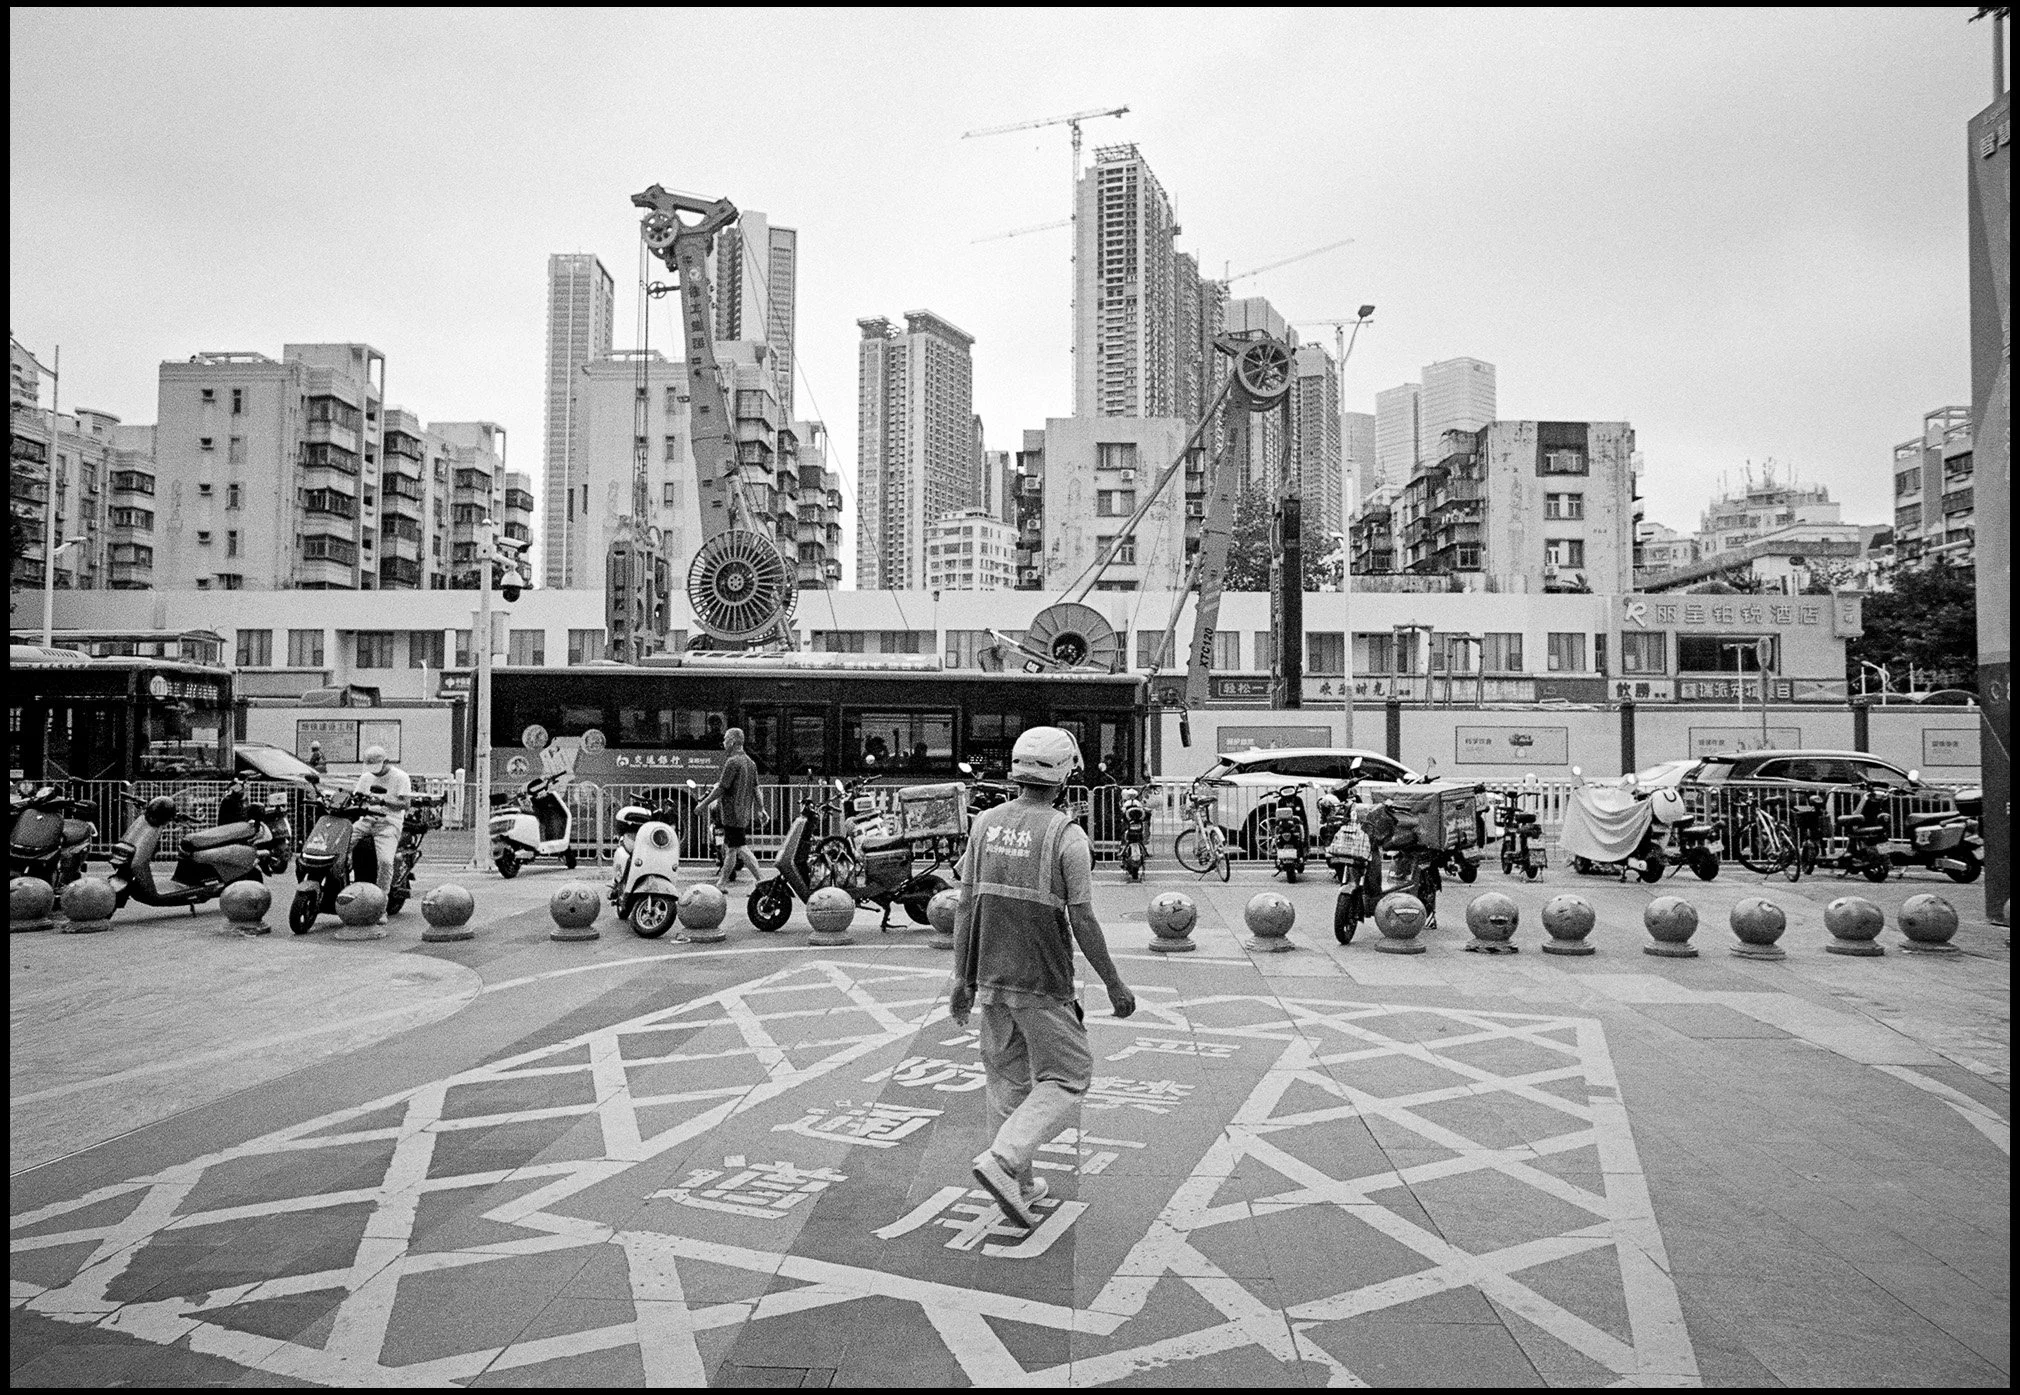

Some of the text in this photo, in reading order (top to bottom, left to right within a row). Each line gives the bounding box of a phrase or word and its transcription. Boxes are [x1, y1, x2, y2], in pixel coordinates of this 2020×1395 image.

[1200, 627, 1214, 668] XTC120
[634, 754, 681, 765] 交通银行
[1002, 827, 1032, 848] 朴朴
